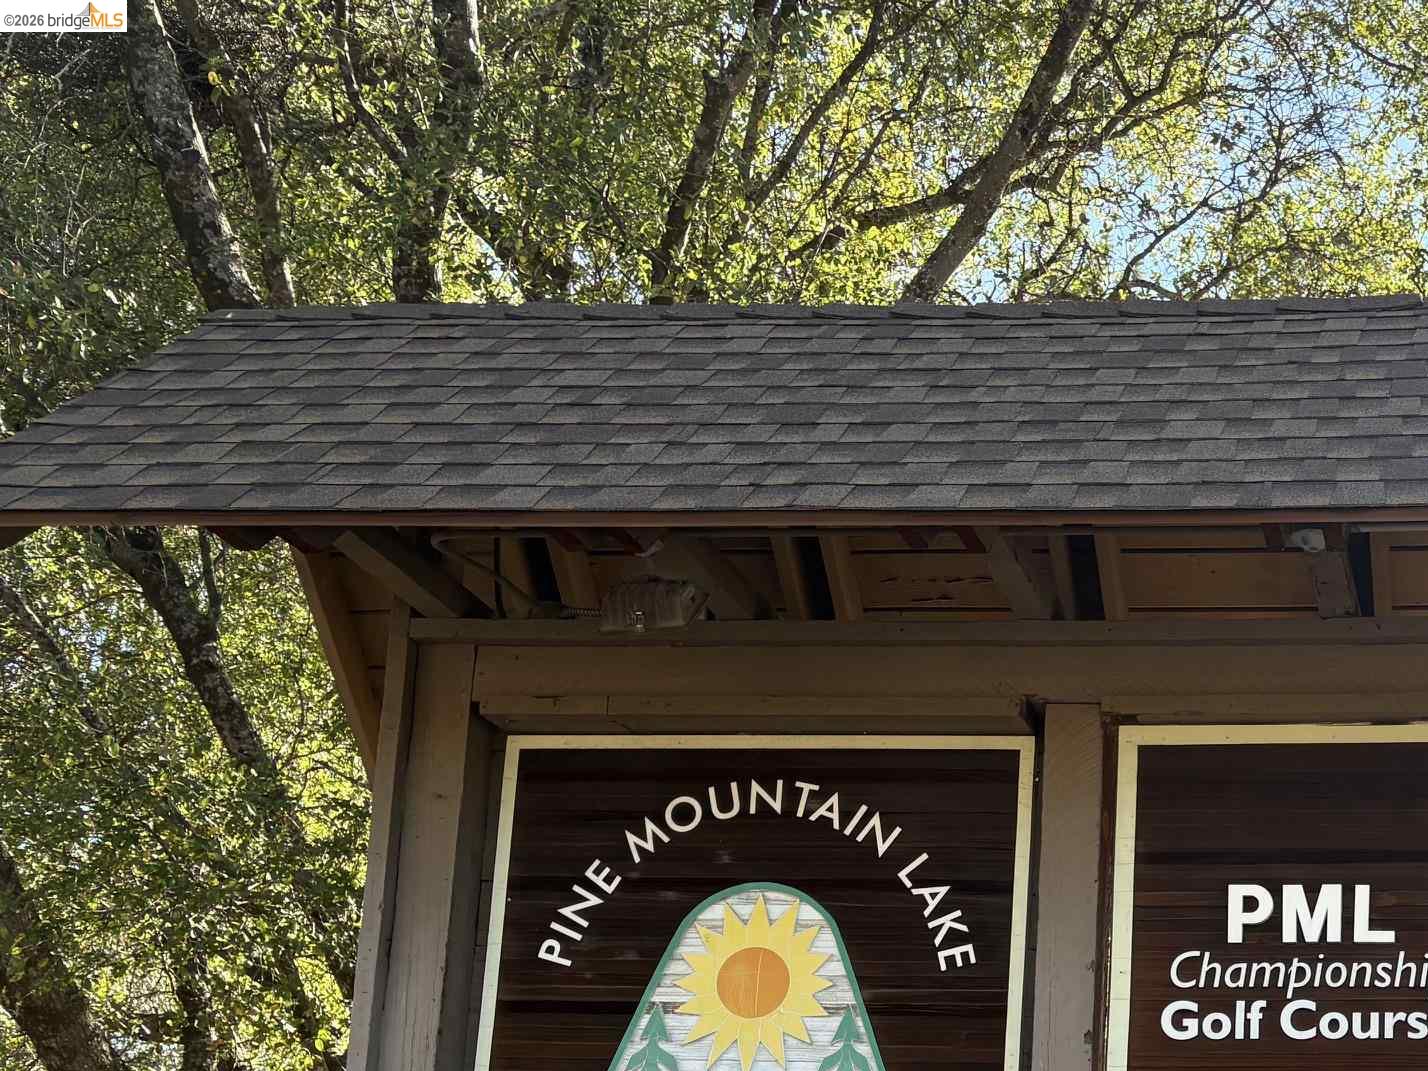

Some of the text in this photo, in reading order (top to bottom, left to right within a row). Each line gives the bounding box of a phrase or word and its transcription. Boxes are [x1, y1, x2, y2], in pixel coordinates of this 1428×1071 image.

[537, 778, 977, 972] PINE MOUNTAIN LAKE
[1227, 884, 1395, 943] PML
[1160, 999, 1267, 1041] Golf
